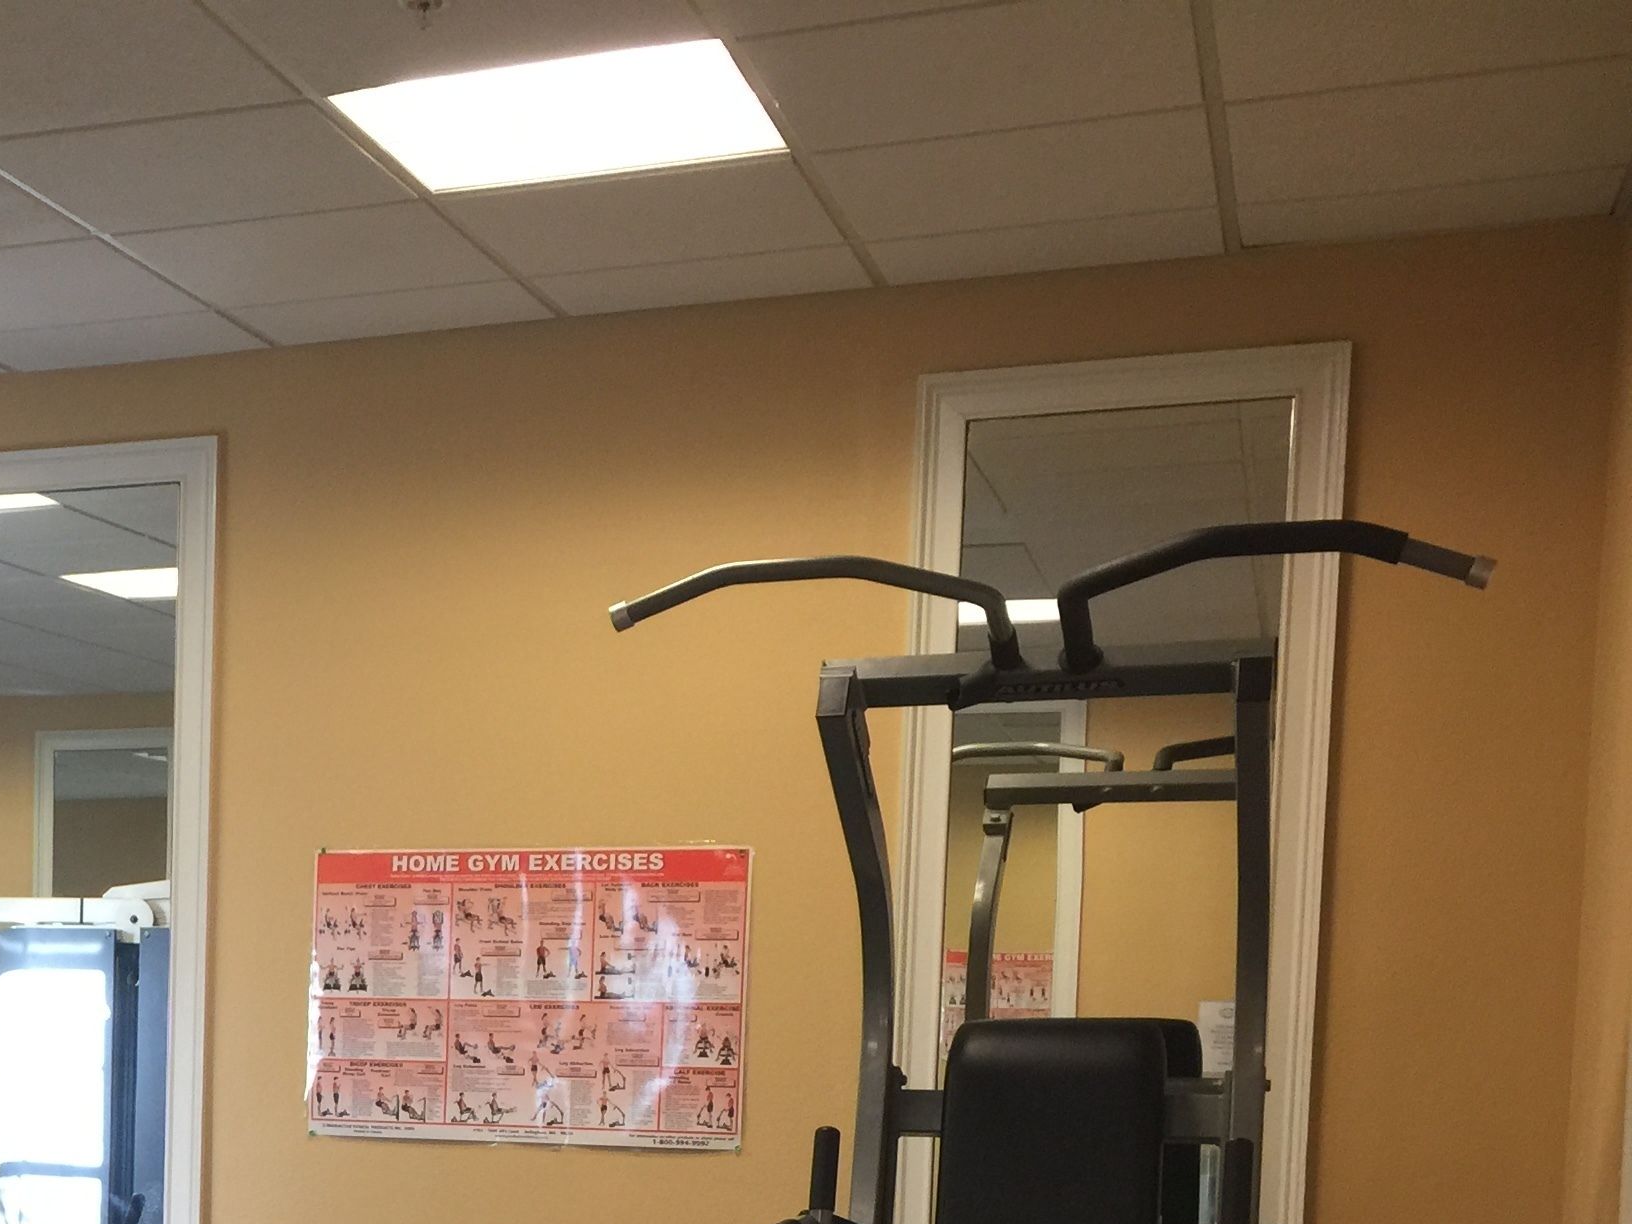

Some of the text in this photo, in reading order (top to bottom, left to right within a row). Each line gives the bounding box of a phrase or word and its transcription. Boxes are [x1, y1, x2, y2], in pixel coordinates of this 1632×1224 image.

[392, 853, 664, 872] HOME GYM EXERCISES
